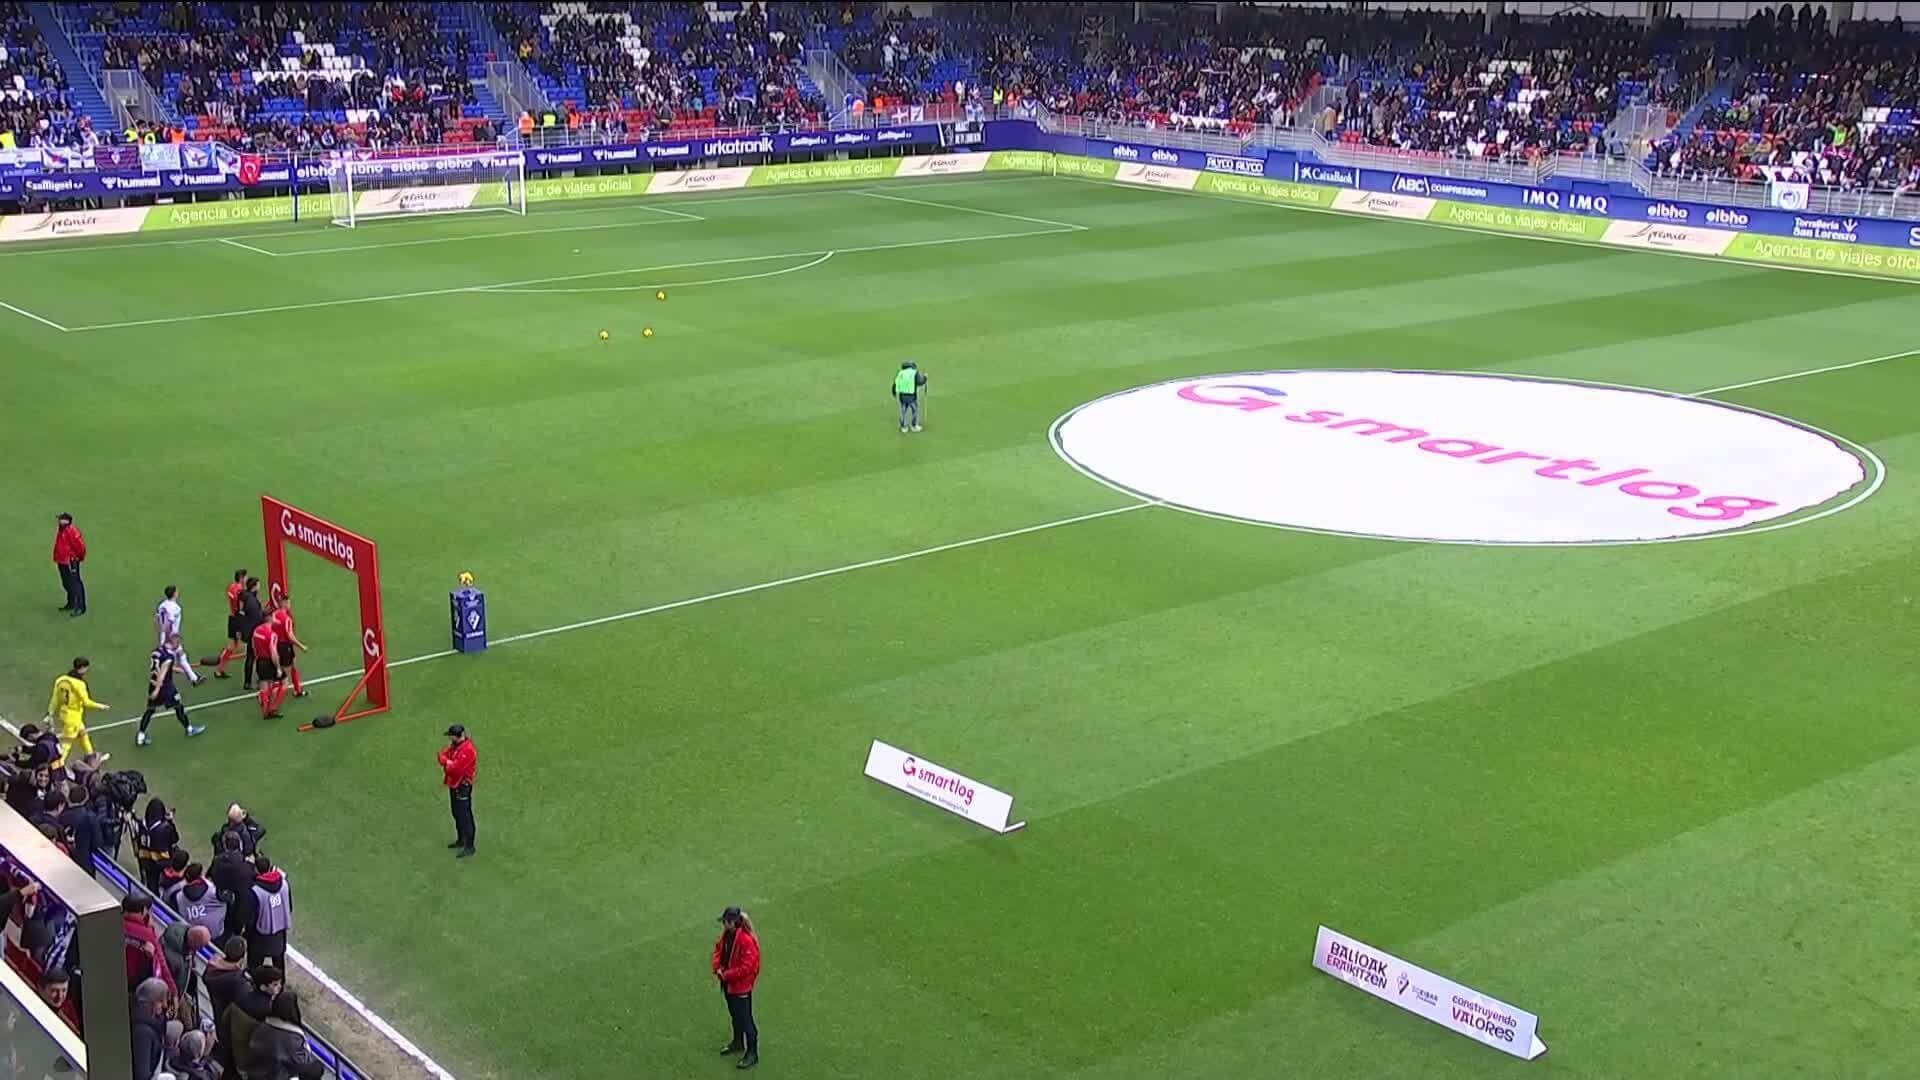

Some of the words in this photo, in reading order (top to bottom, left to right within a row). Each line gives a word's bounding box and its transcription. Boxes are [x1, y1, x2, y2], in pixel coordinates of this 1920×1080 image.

[704, 138, 774, 156] urkotronik
[117, 177, 161, 188] hummel
[183, 174, 226, 186] hummel
[1312, 167, 1353, 184] CaixaBank
[564, 181, 596, 196] viajes
[600, 179, 632, 193] oficial
[1522, 189, 1560, 209] IMQ
[1569, 194, 1608, 214] IMQ
[171, 207, 227, 225] Agencia
[232, 203, 249, 218] de
[253, 202, 291, 219] viajes
[1450, 205, 1494, 224] Agencia
[1497, 209, 1512, 224] de
[1515, 212, 1547, 231] viajes
[1551, 217, 1586, 234] oficial
[1648, 203, 1688, 219] eibho
[1706, 208, 1749, 225] eibho
[1793, 226, 1813, 237] San
[1815, 229, 1857, 242] Lorenzo
[1753, 239, 1811, 258] Agencia
[1815, 245, 1836, 260] de
[1839, 247, 1882, 267] viajes
[1285, 409, 1778, 521] smartlog
[298, 524, 355, 569] smartlog
[918, 767, 975, 806] smartlog
[187, 904, 207, 919] 102
[1452, 994, 1517, 1028] construyendo
